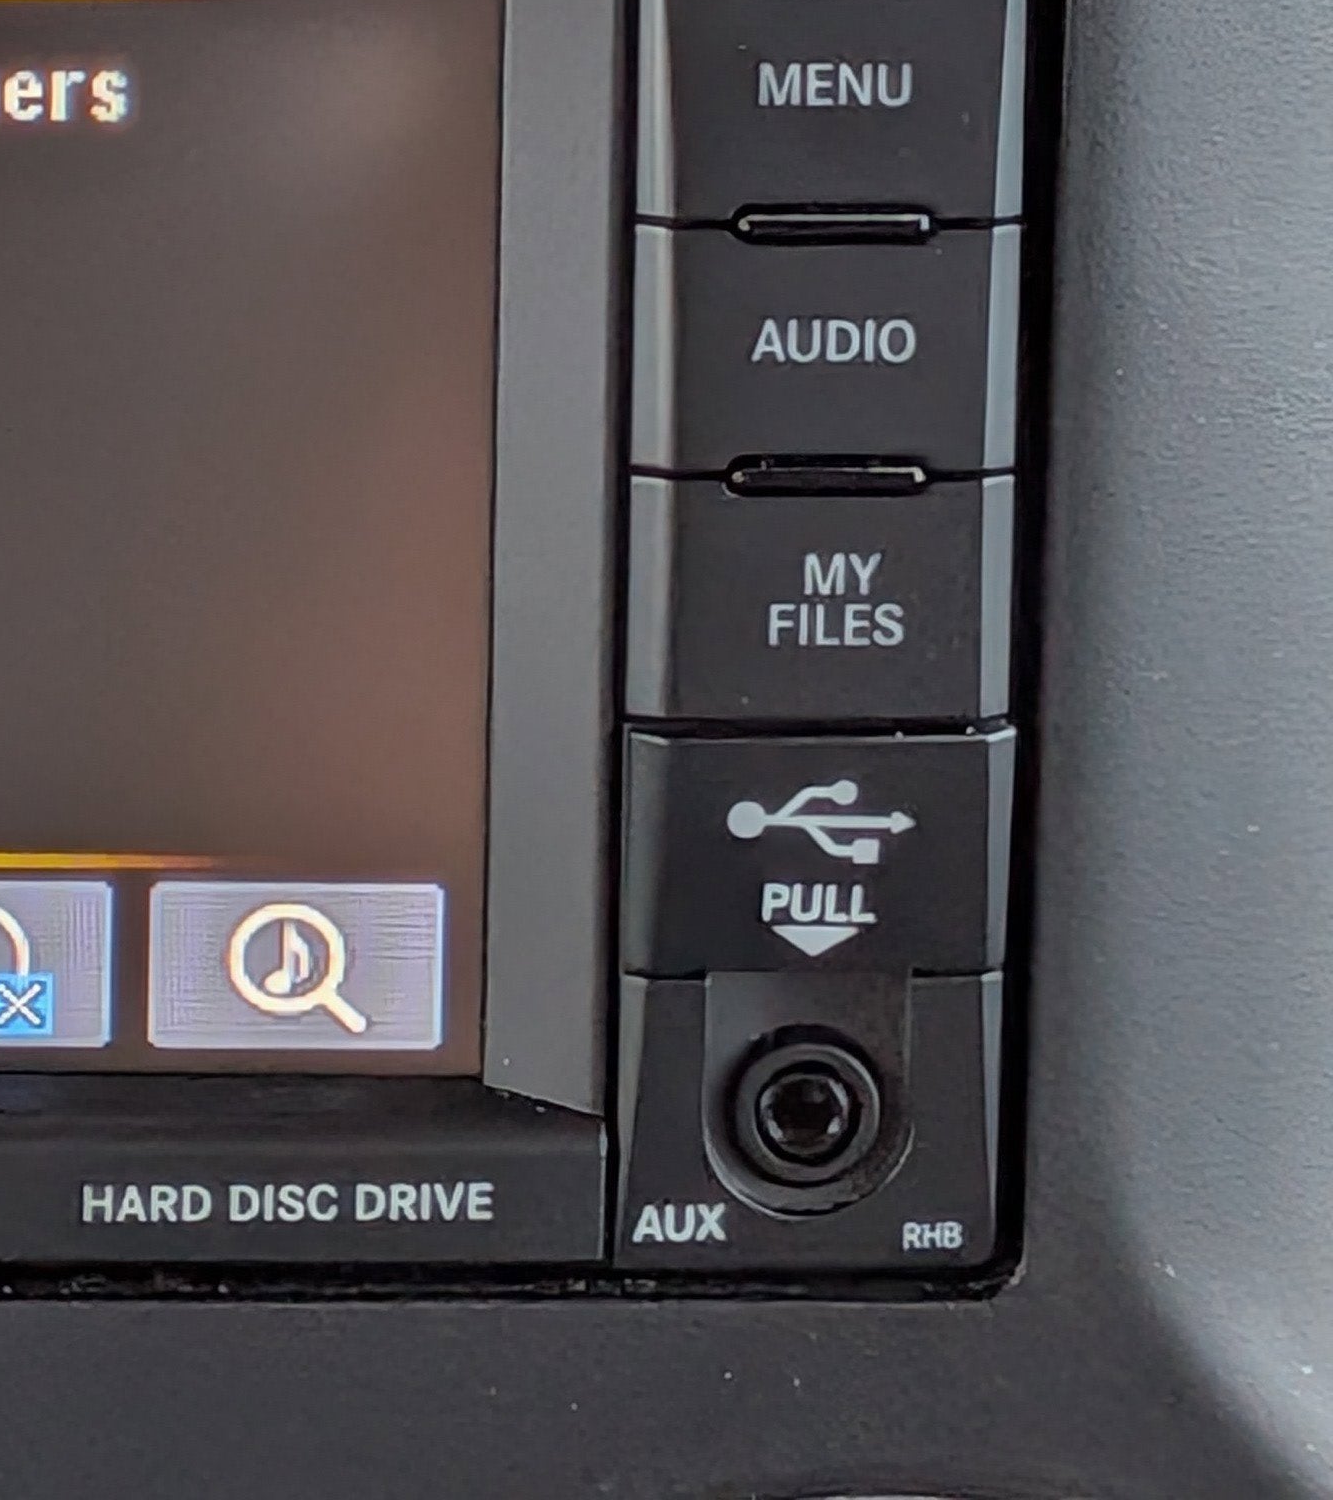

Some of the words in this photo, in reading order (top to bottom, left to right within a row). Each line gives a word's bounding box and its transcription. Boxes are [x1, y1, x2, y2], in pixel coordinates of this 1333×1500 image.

[757, 62, 913, 107] MENU
[751, 318, 916, 363] AUDIO
[804, 553, 881, 595] MY
[768, 603, 904, 648] FILES
[761, 882, 876, 924] PULL
[81, 1184, 212, 1224] HARD
[228, 1183, 340, 1223] DISC
[355, 1182, 494, 1222] DRIVE
[633, 1204, 727, 1244] AUX
[902, 1221, 964, 1250] RHB
